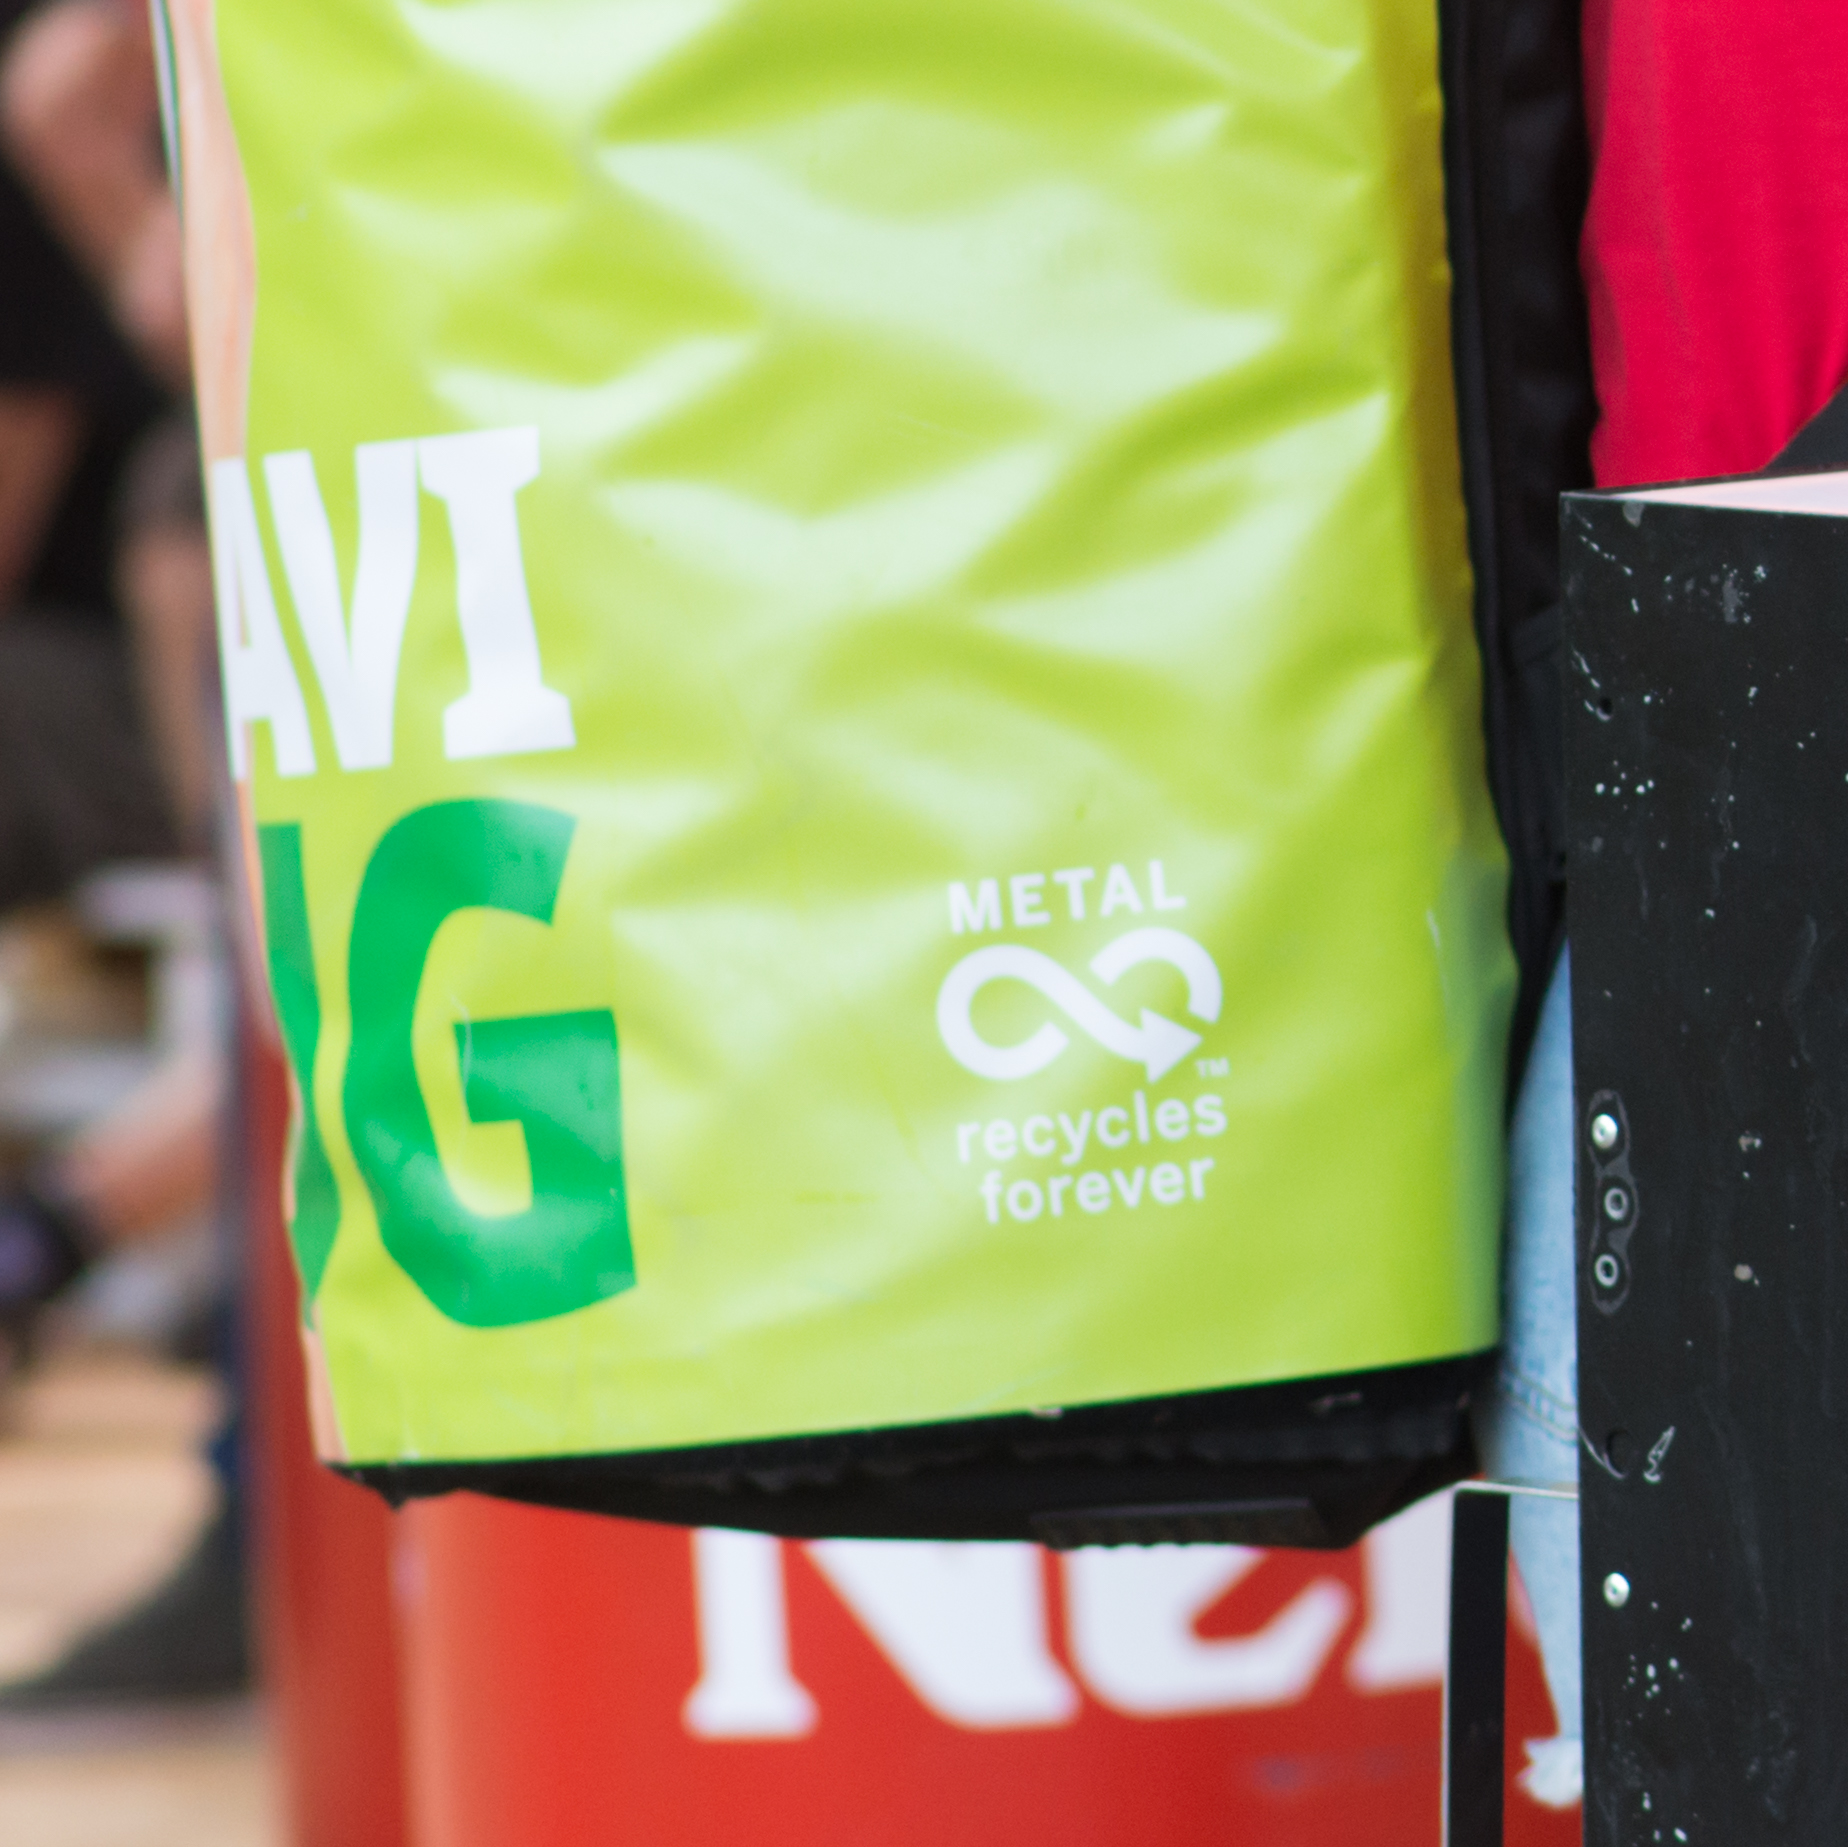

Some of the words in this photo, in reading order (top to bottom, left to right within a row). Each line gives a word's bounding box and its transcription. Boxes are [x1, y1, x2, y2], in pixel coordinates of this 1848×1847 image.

[947, 858, 1188, 936] METAL
[955, 1089, 1229, 1166] recycles
[978, 1156, 1217, 1225] forever
